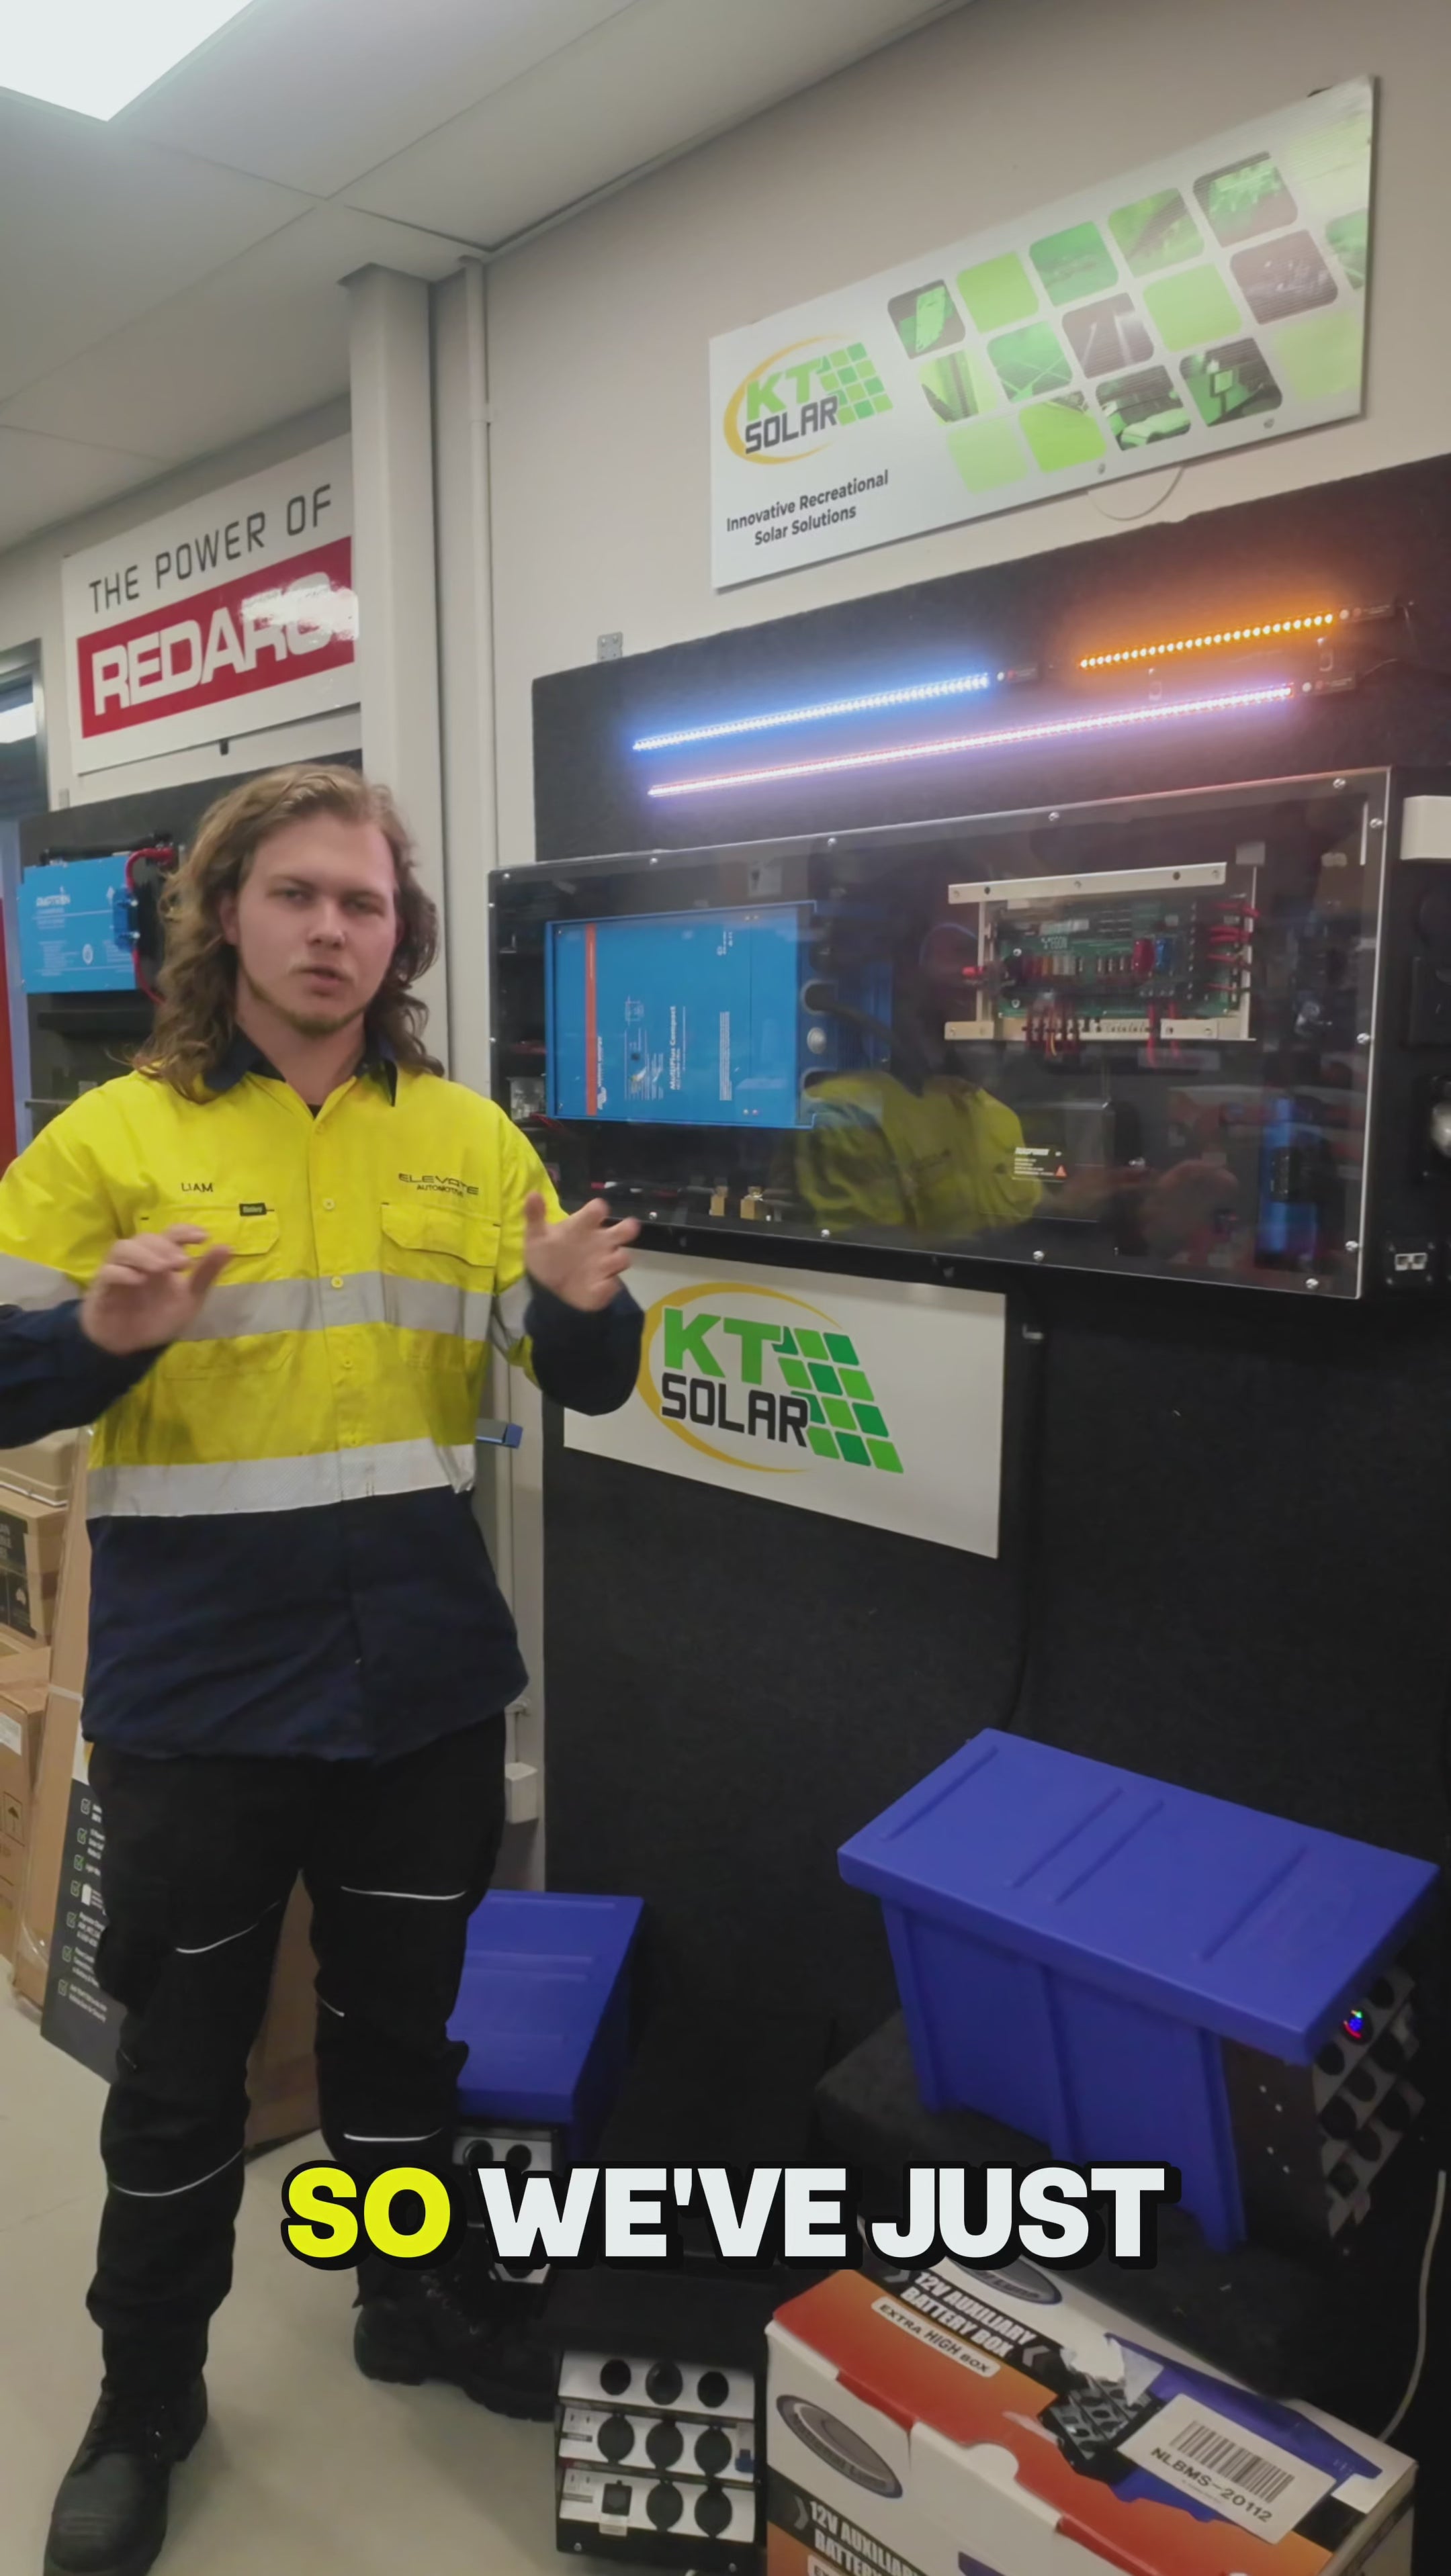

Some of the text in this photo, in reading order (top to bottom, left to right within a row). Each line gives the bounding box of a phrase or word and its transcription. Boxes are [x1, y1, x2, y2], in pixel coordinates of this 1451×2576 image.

[746, 357, 822, 422] KT
[745, 395, 839, 455] SOLAR
[727, 469, 889, 533] Innovative Recreational
[754, 505, 856, 546] Solar Solutions
[89, 484, 331, 614] THE POWER OF
[181, 1182, 214, 1193] LIAM
[664, 1307, 781, 1385] KT
[661, 1371, 808, 1448] SOLAR
[879, 2303, 991, 2373] EXTRA HIGH BOX
[899, 2285, 1014, 2358] BATTERY BOX
[914, 2271, 952, 2297] 12V
[942, 2291, 1039, 2346] AUXILIARY
[809, 2500, 839, 2535] 12V
[1150, 2447, 1273, 2523] NLBMS-20112
